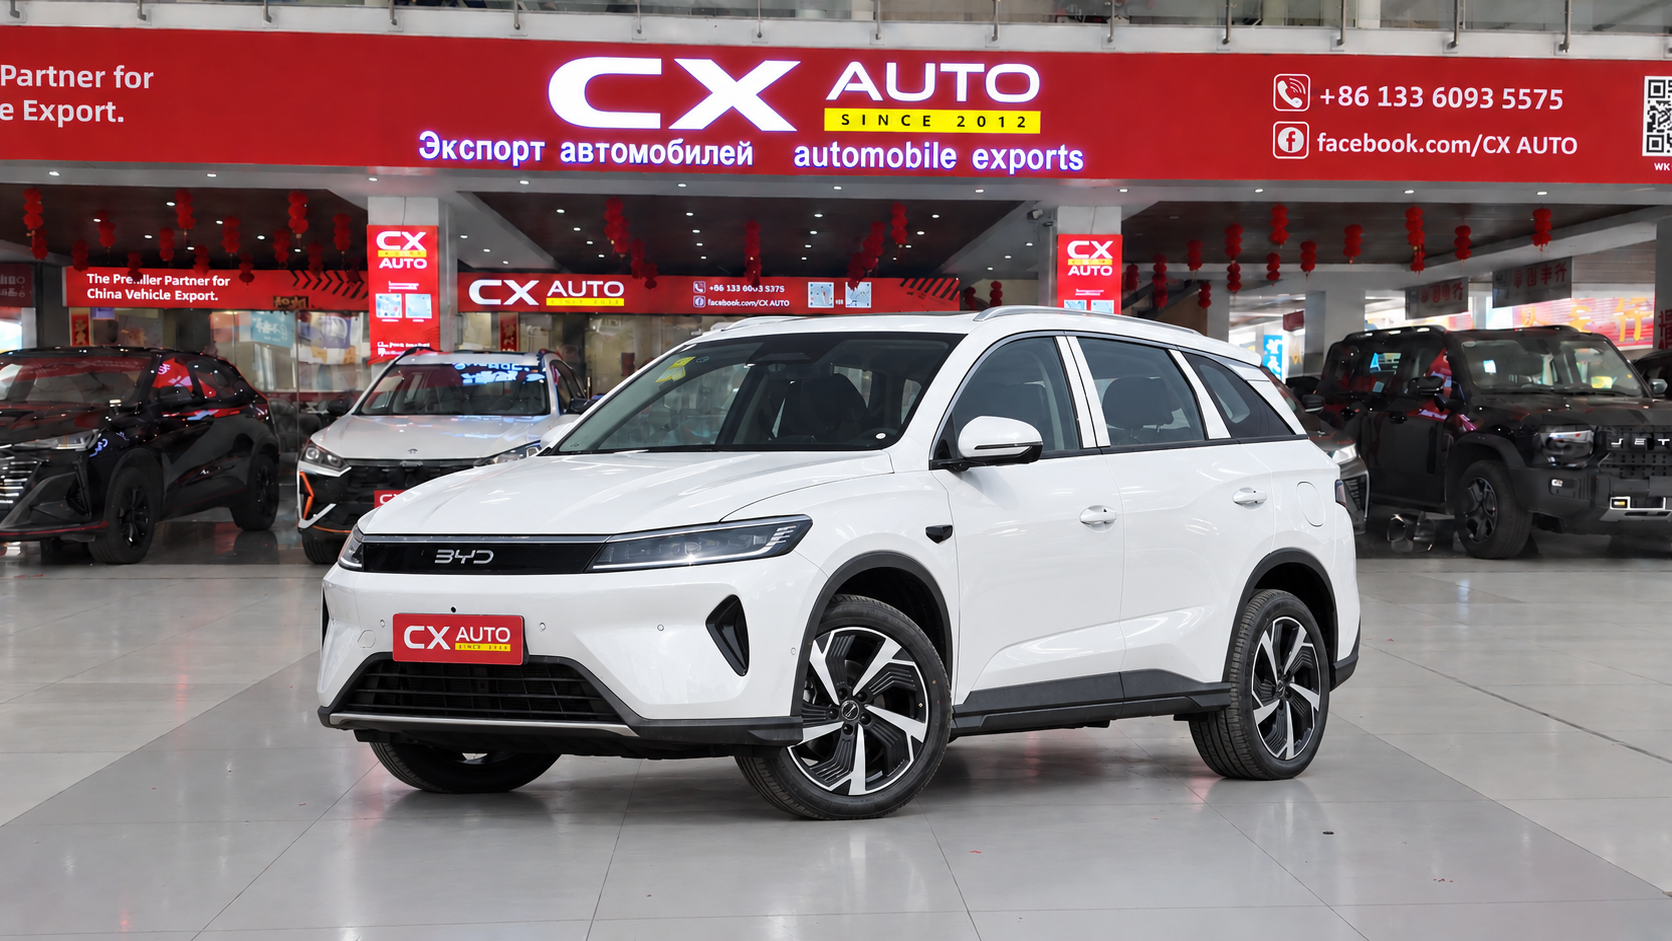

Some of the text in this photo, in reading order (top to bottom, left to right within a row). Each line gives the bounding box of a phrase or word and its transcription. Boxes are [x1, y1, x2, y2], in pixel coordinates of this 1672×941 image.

[0, 65, 153, 88] Partner for
[549, 57, 1040, 131] CX AUTO
[1320, 86, 1563, 109] +86 133 6093 5575
[24, 100, 124, 128] Export.
[842, 114, 1026, 127] SINCE 2012
[419, 131, 753, 167] Экспорт автомобилей
[1317, 133, 1578, 158] facebook.com/CX AUTO
[794, 141, 1084, 175] automobile exports
[375, 231, 427, 250] CX
[1066, 240, 1114, 259] CX
[379, 257, 428, 269] AUTO
[1067, 265, 1113, 276] AUTO
[86, 273, 110, 285] The
[164, 275, 210, 286] Partner
[212, 275, 231, 287] for
[726, 284, 741, 293] 133
[86, 288, 219, 303] China Vehicle Export.
[468, 279, 625, 306] CX AUTO
[769, 299, 790, 307] AUTO
[434, 549, 494, 564] BYD
[403, 625, 511, 650] CX AUTO
